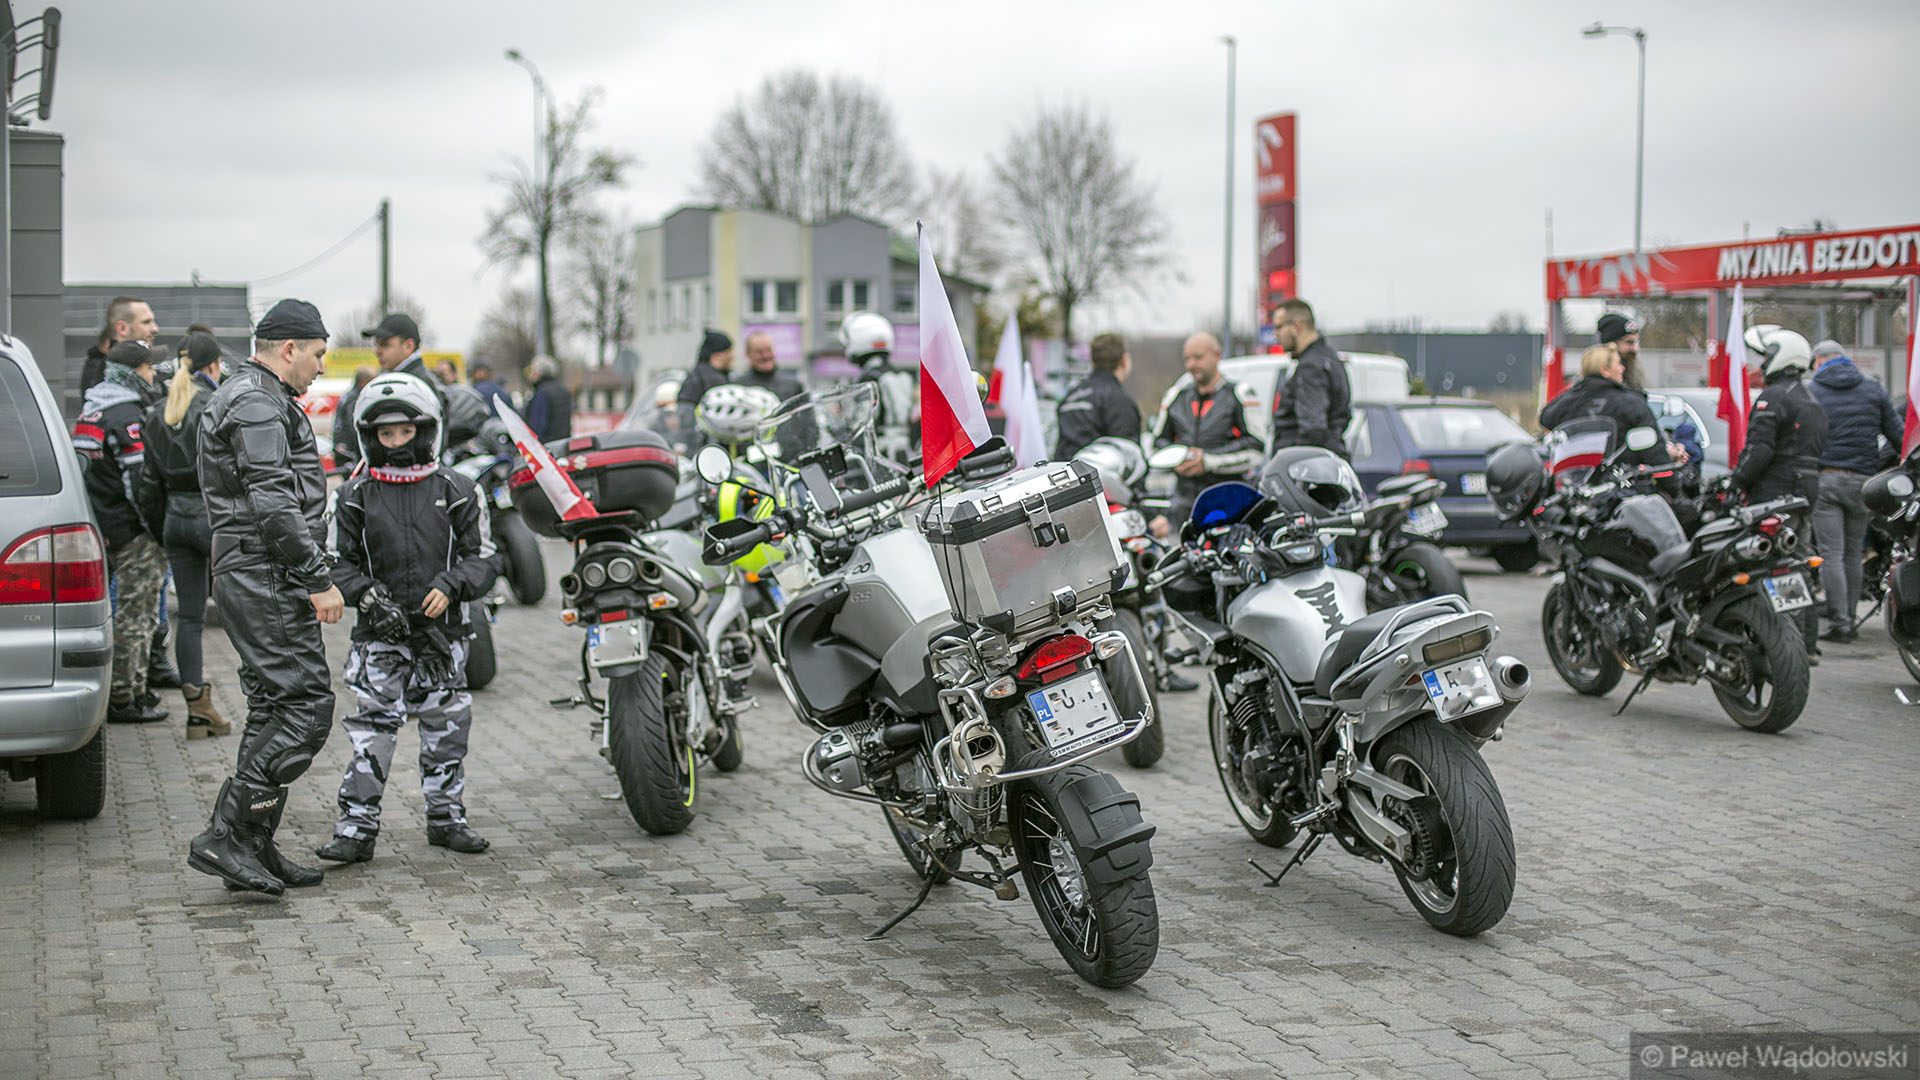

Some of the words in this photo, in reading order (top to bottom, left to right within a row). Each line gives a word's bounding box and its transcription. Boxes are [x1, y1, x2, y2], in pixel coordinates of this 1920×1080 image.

[1718, 242, 1808, 281] MYJNIA
[1429, 686, 1442, 696] PL
[1037, 709, 1051, 720] PL
